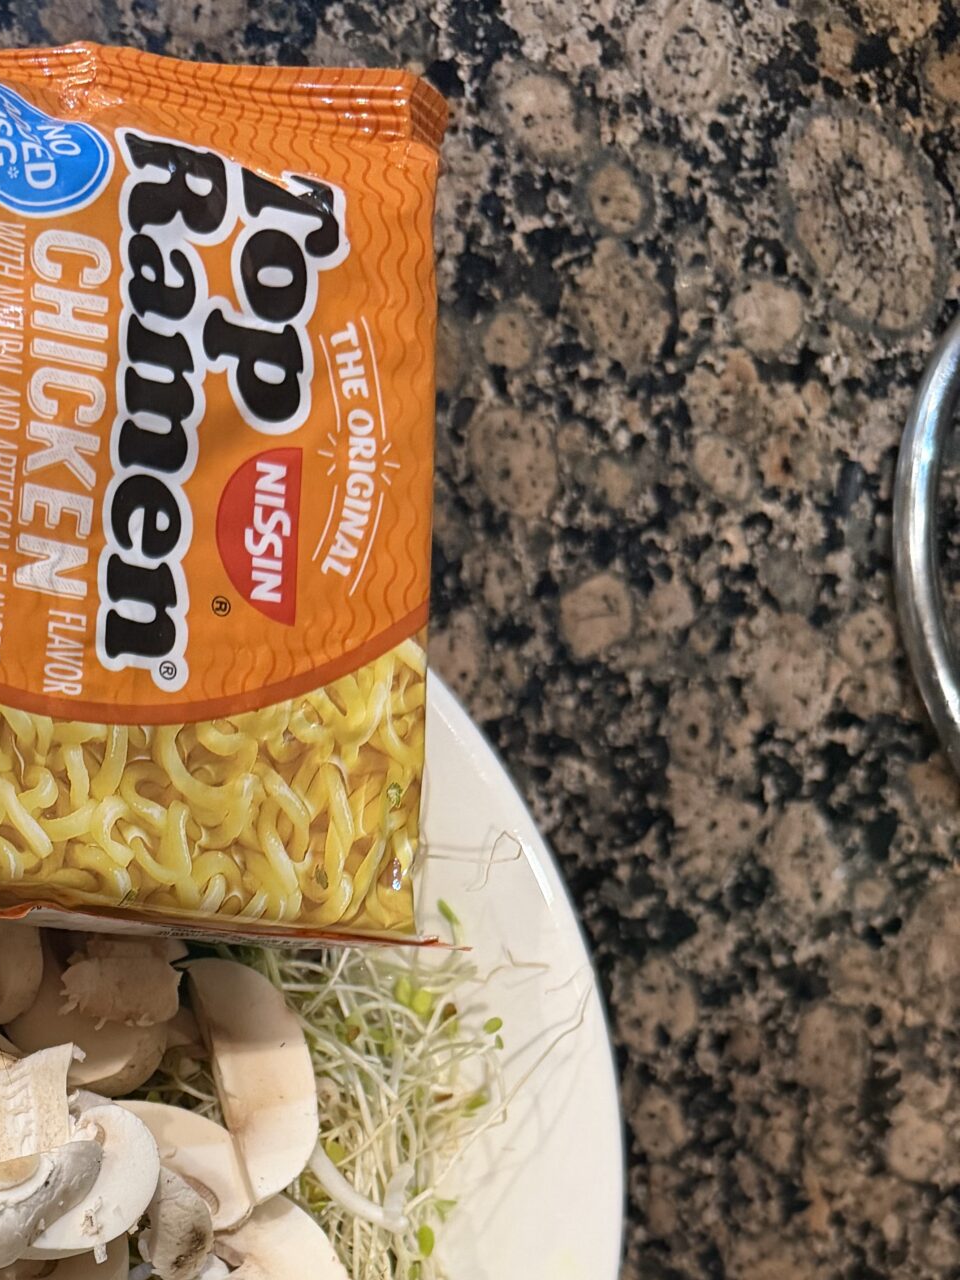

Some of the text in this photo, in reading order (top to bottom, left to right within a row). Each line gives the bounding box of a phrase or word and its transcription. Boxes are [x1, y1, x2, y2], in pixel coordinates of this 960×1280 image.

[36, 123, 82, 156] NO
[104, 132, 229, 660] Ramen
[201, 166, 341, 424] Top
[12, 228, 113, 696] CHICKEN FLAVOR
[243, 460, 292, 604] NISSIN
[320, 321, 377, 577] THE ORIGINAL
